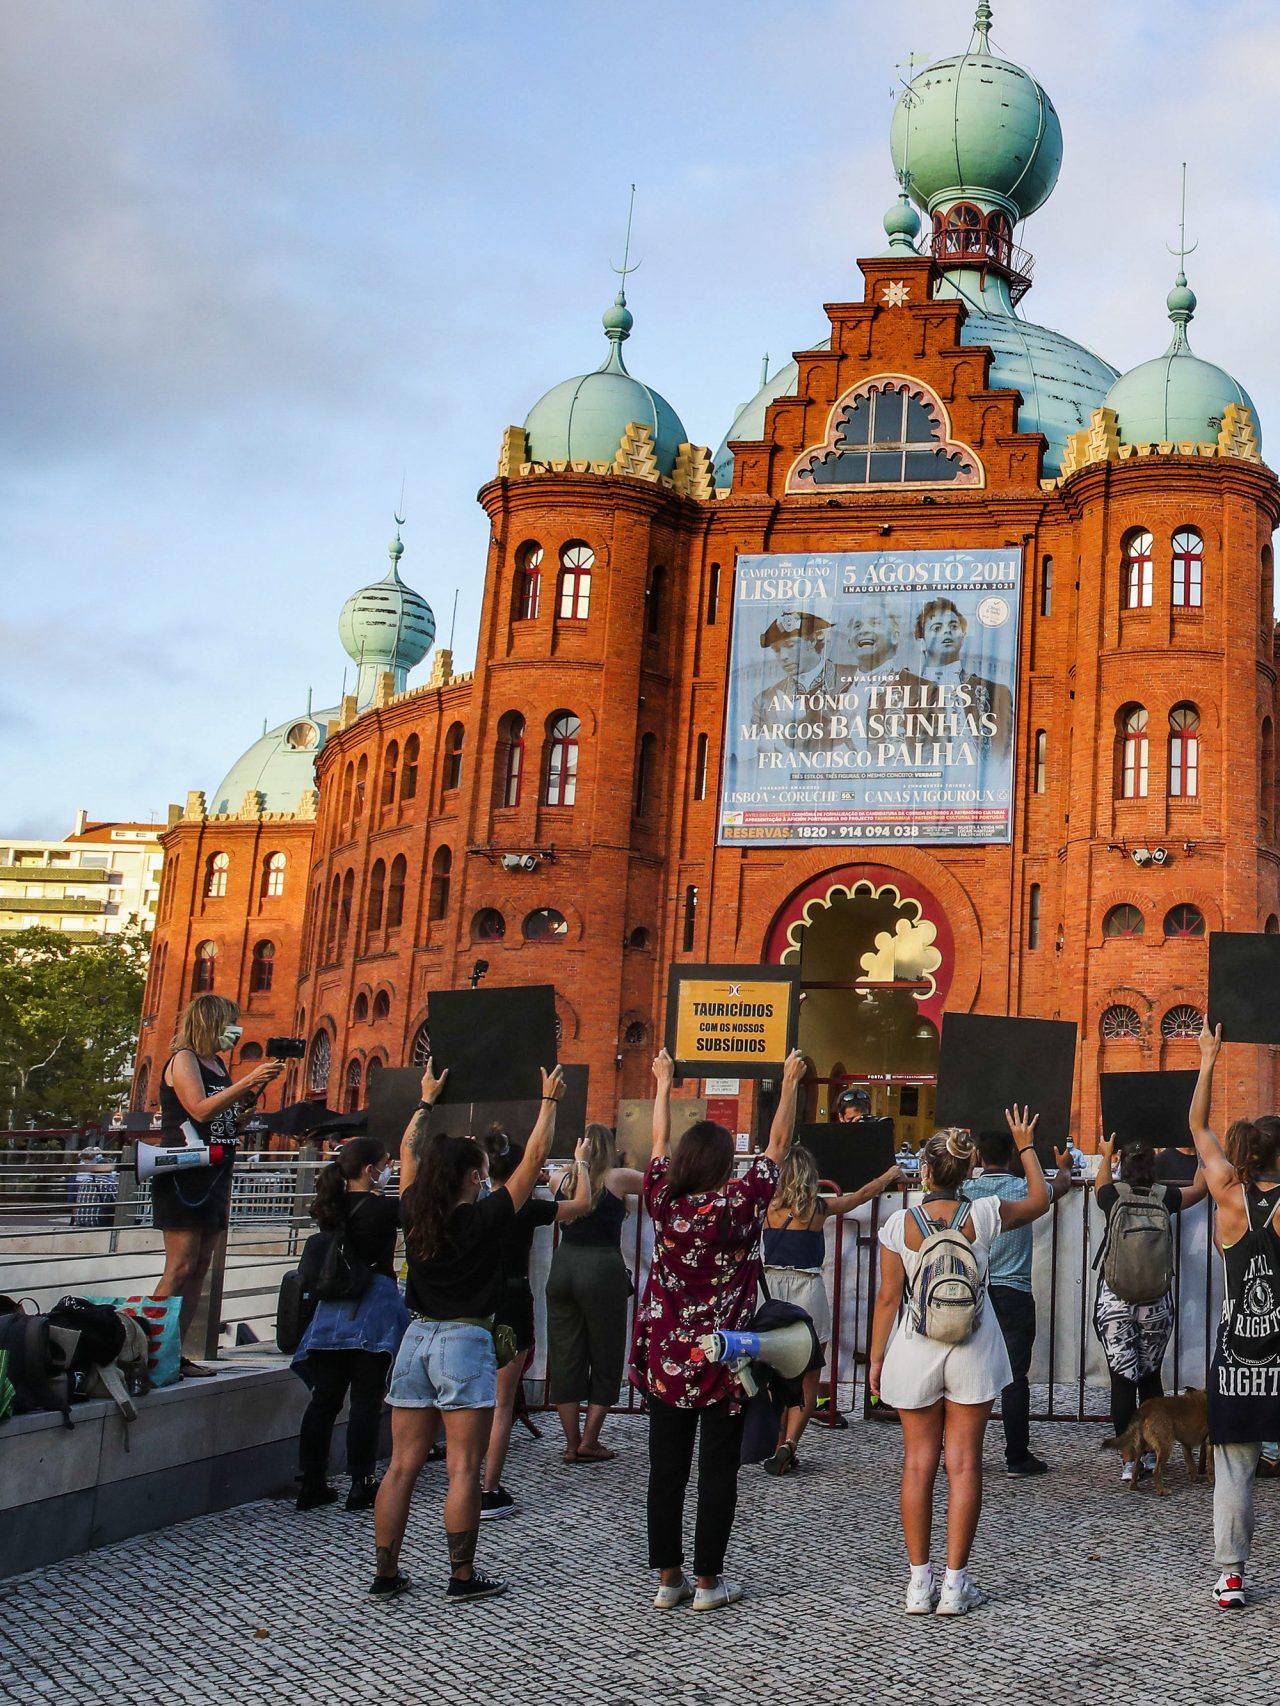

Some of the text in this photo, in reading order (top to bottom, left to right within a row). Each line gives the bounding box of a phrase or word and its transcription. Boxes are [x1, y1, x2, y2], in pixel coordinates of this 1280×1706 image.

[740, 567, 830, 579] CAMPO PEQUENO
[843, 561, 1016, 585] 5 AGOSTO 20H
[740, 578, 828, 600] LISBOA
[845, 584, 912, 593] INAUGURAÇÃO
[932, 583, 988, 591] TEMPORADA
[840, 675, 900, 683] CAVALEIROS
[768, 683, 972, 712] ANTÓNIO TELLES
[740, 712, 998, 741] MARCOS BASTINHAS
[758, 742, 977, 769] FRANCISCO PALHA
[724, 790, 769, 803] LISBOA
[778, 790, 840, 803] CORUCHE
[864, 789, 994, 803] CANAS VIGOUROUX
[724, 827, 794, 838] RESERVAS:
[797, 826, 828, 838] 1820
[840, 826, 862, 838] 914
[866, 826, 890, 837] 094
[894, 826, 919, 837] 038
[693, 1000, 774, 1018] TAURICÍDIOS
[700, 1022, 765, 1033] COM OS NOSSOS
[696, 1036, 766, 1053] SUBSÍDIOS
